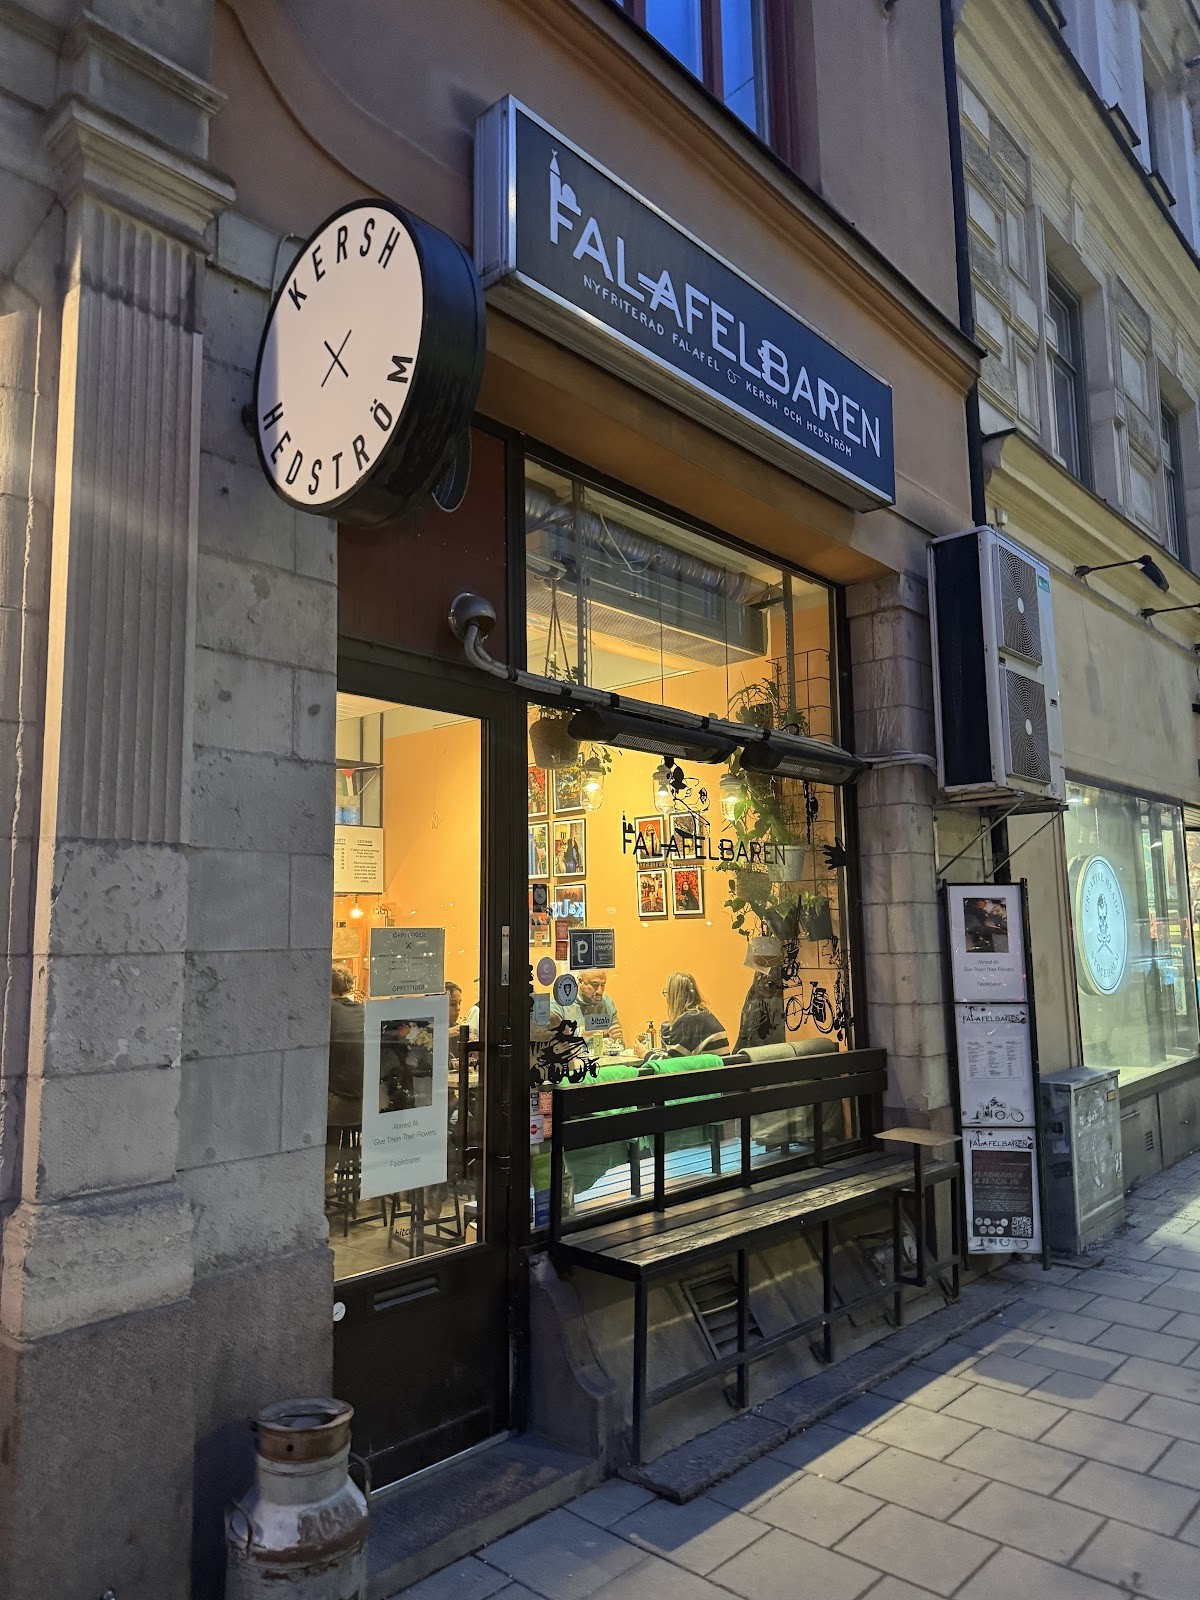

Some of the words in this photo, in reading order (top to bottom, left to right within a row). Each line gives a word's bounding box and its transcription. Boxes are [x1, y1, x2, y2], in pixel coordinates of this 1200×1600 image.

[287, 217, 401, 311] KERSH
[550, 149, 881, 458] FALAFELBAREN
[583, 274, 665, 336] NYFRITERAD
[672, 332, 720, 372] FALAFEL
[745, 381, 778, 410] KERSH
[783, 406, 802, 425] OCH
[806, 420, 852, 458] HEDSTRÖM
[263, 354, 414, 496] HEDSTRÖM
[622, 811, 787, 866] FALAFELBAREN
[1091, 951, 1120, 978] STOCKHOLM
[391, 984, 425, 992] ÖPPETTIDER
[591, 1016, 610, 1025] bitcoin
[373, 1138, 386, 1146] Give
[387, 1136, 401, 1144] Them
[416, 1130, 437, 1138] Flowers
[392, 1121, 411, 1130] Ahmed
